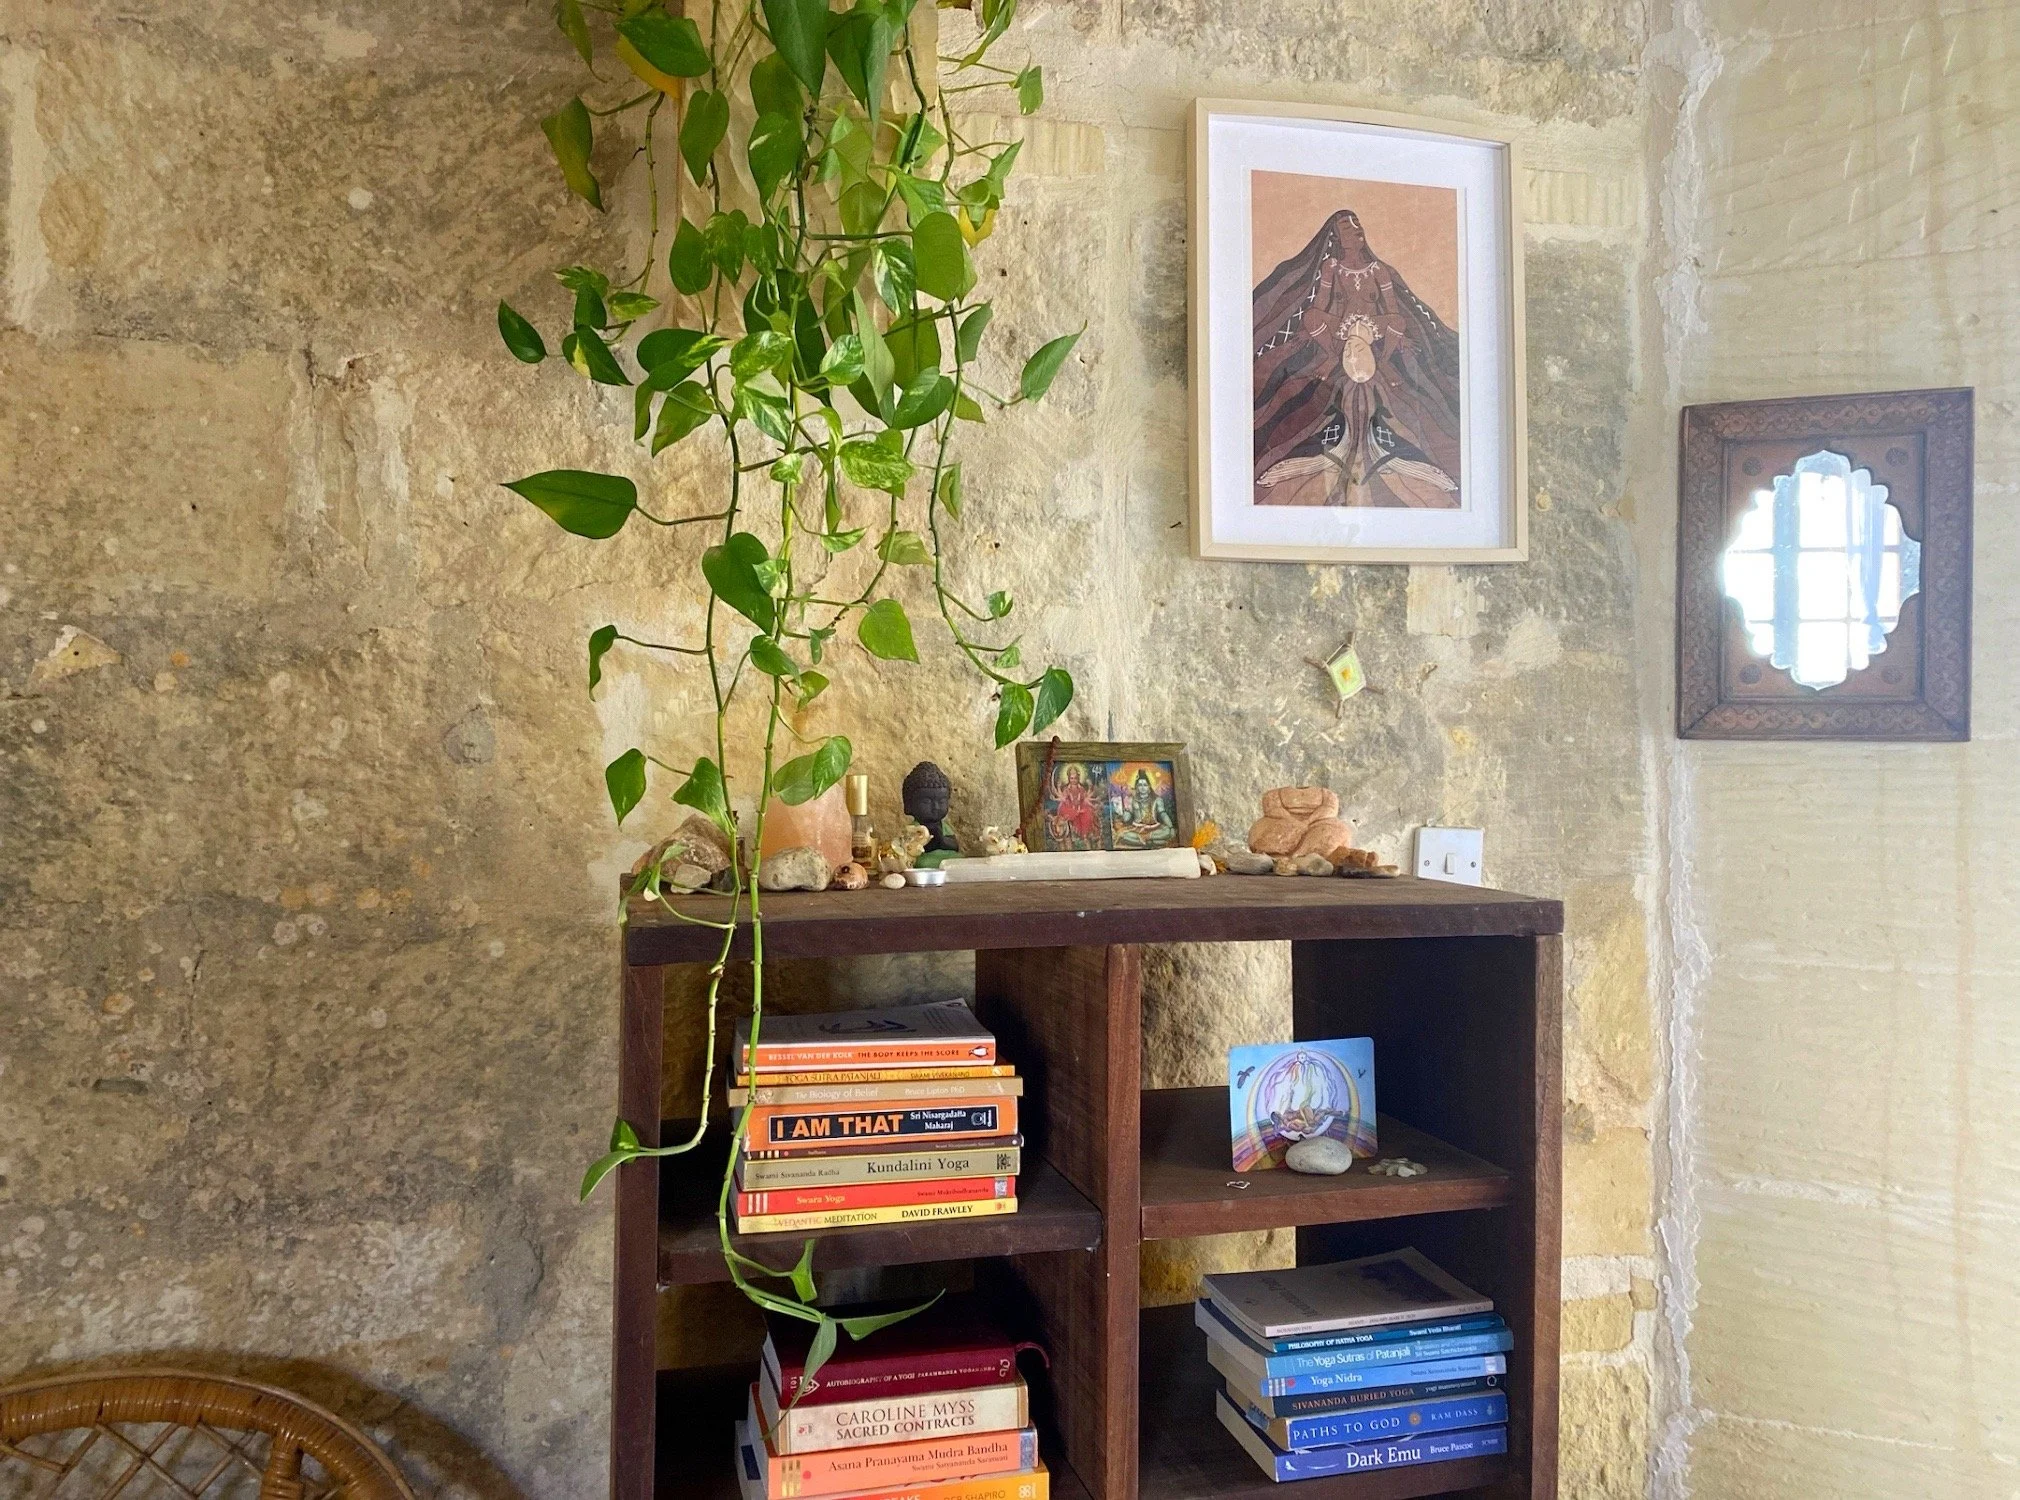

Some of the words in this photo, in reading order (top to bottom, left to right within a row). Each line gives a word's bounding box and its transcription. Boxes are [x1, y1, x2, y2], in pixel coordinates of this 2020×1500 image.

[841, 1072, 881, 1081] PATANJALI
[795, 1091, 808, 1099] The
[809, 1088, 841, 1100] Biology
[843, 1088, 852, 1097] of
[854, 1086, 879, 1097] Belief
[905, 1088, 926, 1096] Bruce
[926, 1086, 949, 1096] Lipton
[910, 1111, 921, 1120] Sri
[776, 1119, 784, 1139] I
[792, 1117, 830, 1138] AM
[838, 1114, 904, 1135] THAT
[924, 1121, 954, 1131] Maharaj
[867, 1157, 932, 1174] Kundalini
[938, 1158, 970, 1172] Yoga
[755, 1171, 779, 1180] Swami
[781, 1170, 816, 1178] Sivananda
[818, 1169, 840, 1177] Radha
[825, 1194, 846, 1204] Yoga
[824, 1212, 877, 1223] MEDITATION
[901, 1206, 930, 1218] DAVID
[932, 1204, 973, 1216] FRAWLEY
[1288, 1340, 1325, 1350] PHILOSOPHY
[1297, 1357, 1314, 1368] The
[1313, 1356, 1336, 1368] Yoga
[1337, 1352, 1366, 1364] Sutras
[1366, 1351, 1375, 1360] of
[1375, 1345, 1411, 1360] Patanjali
[826, 1377, 882, 1388] AUTOBIOGRAPHY
[899, 1372, 915, 1380] YOGI
[1311, 1376, 1334, 1388] Yoga
[1335, 1372, 1363, 1384] Nidra
[1292, 1397, 1348, 1411] SIVANANDA
[1349, 1391, 1387, 1403] BURIED
[1388, 1387, 1415, 1398] YOGA
[836, 1404, 926, 1426] CAROLINE
[933, 1399, 976, 1417] MYSS
[1431, 1411, 1452, 1421] RAM
[1455, 1408, 1478, 1418] DASS
[837, 1424, 889, 1441] SACRED
[894, 1415, 976, 1433] CONTRACTS
[1293, 1425, 1338, 1441] PATHS
[1343, 1422, 1363, 1434] TO
[1369, 1416, 1401, 1431] GOD
[1430, 1445, 1450, 1454] Bruce
[1450, 1442, 1474, 1452] Pascoe
[829, 1458, 862, 1472] Asana
[865, 1452, 925, 1468] Pranayama
[928, 1446, 964, 1461] Mudra
[967, 1442, 1009, 1456] Bandha
[1346, 1448, 1384, 1469] Dark
[1388, 1446, 1421, 1463] Emu
[911, 1464, 934, 1472] Swami
[965, 1490, 1006, 1500] SHAPIRO
